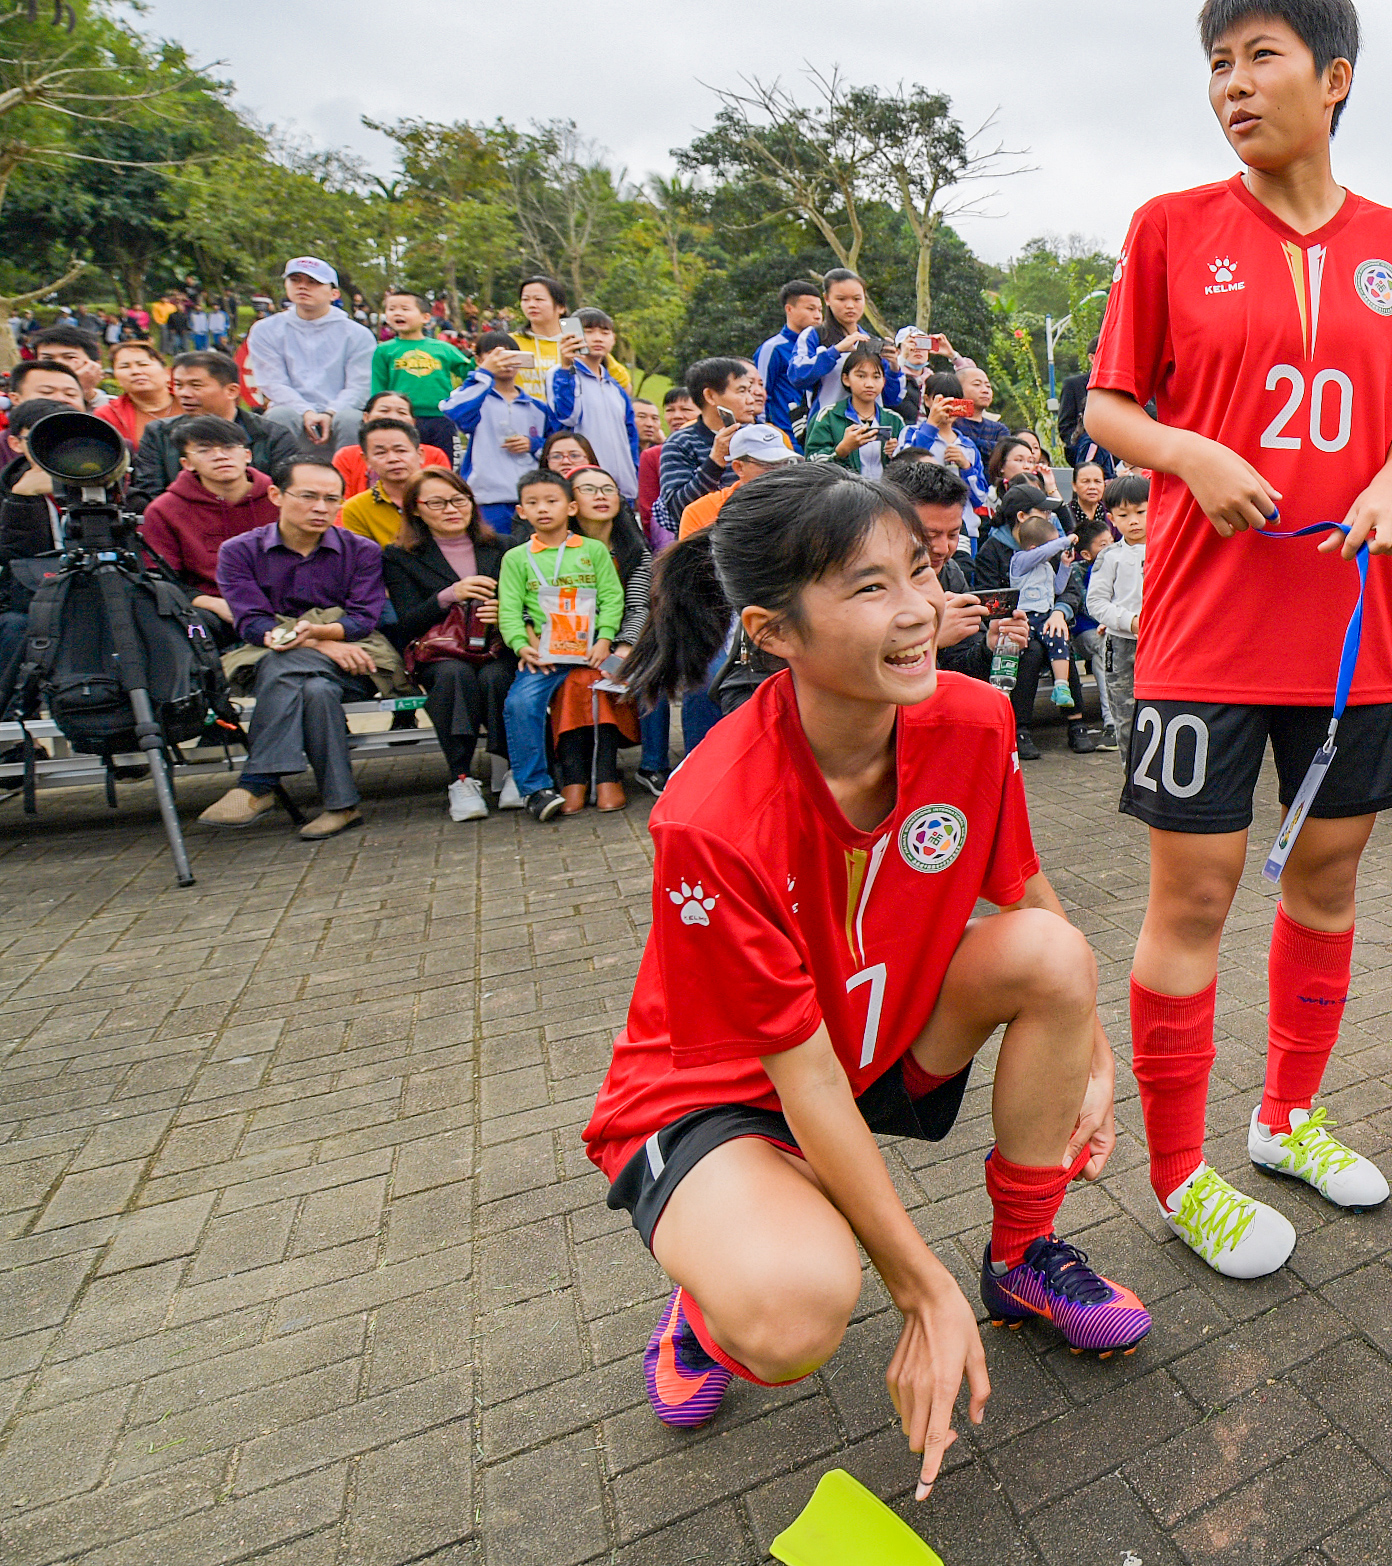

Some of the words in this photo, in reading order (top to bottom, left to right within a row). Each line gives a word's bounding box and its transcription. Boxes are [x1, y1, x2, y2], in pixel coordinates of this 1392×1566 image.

[1204, 281, 1245, 295] KELME
[1260, 363, 1353, 453] 20
[1133, 706, 1209, 798] 20
[683, 914, 709, 923] KELME
[846, 962, 887, 1069] 7
